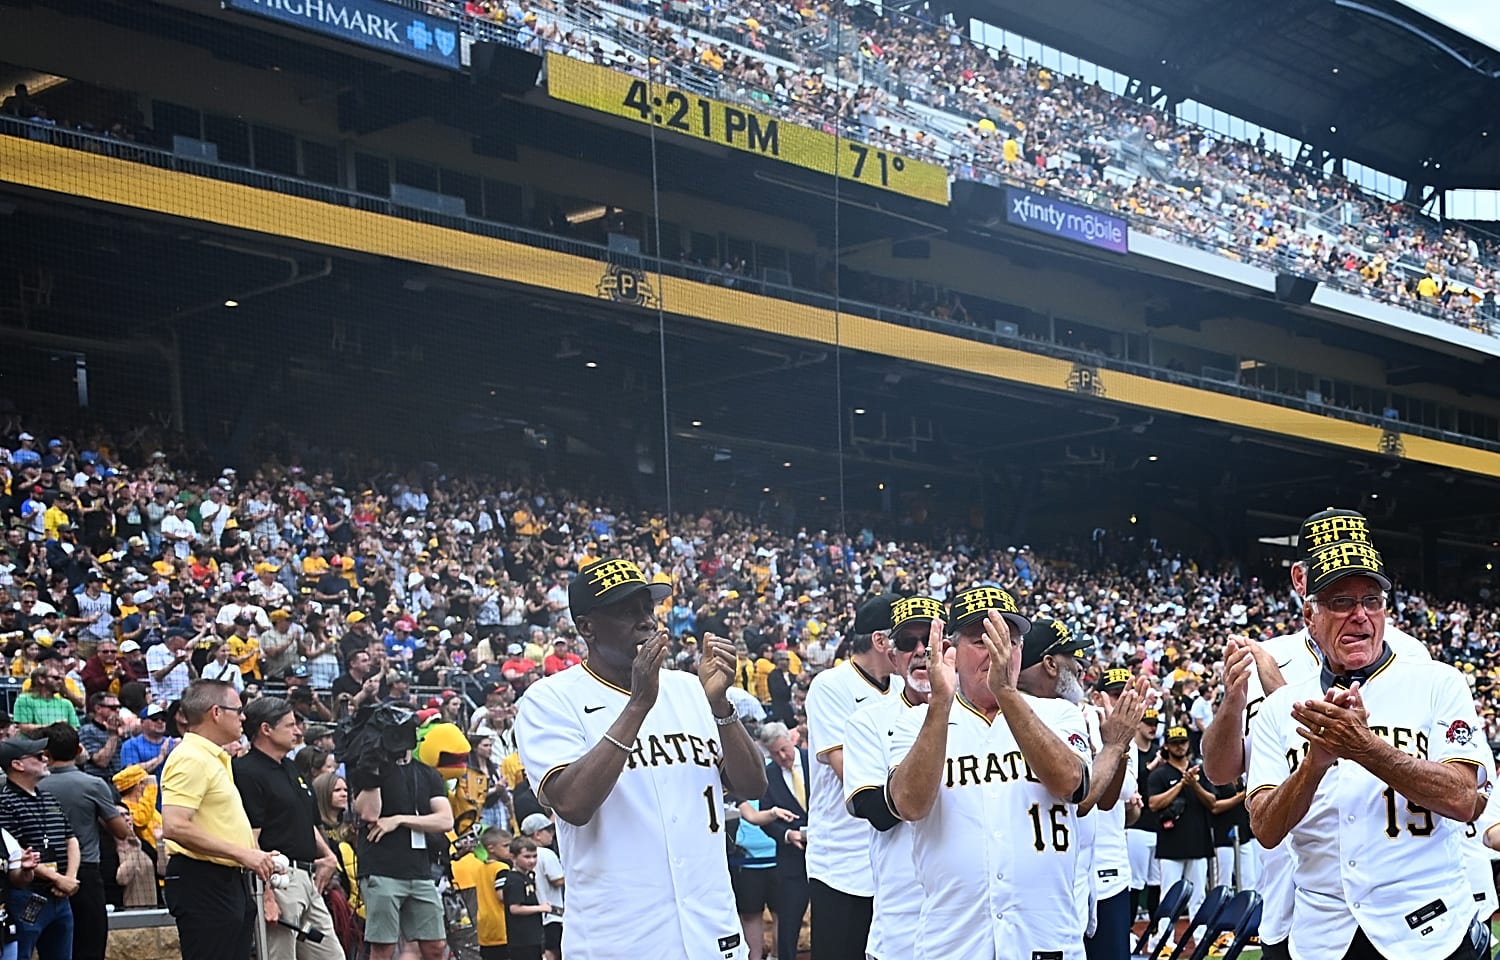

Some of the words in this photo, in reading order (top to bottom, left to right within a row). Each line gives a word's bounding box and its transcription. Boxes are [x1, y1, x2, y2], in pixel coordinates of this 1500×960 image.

[622, 80, 712, 137] 4:21
[724, 107, 779, 155] PM
[1013, 196, 1066, 231] xfinity
[1066, 214, 1122, 243] mobile
[1027, 803, 1069, 852] 16
